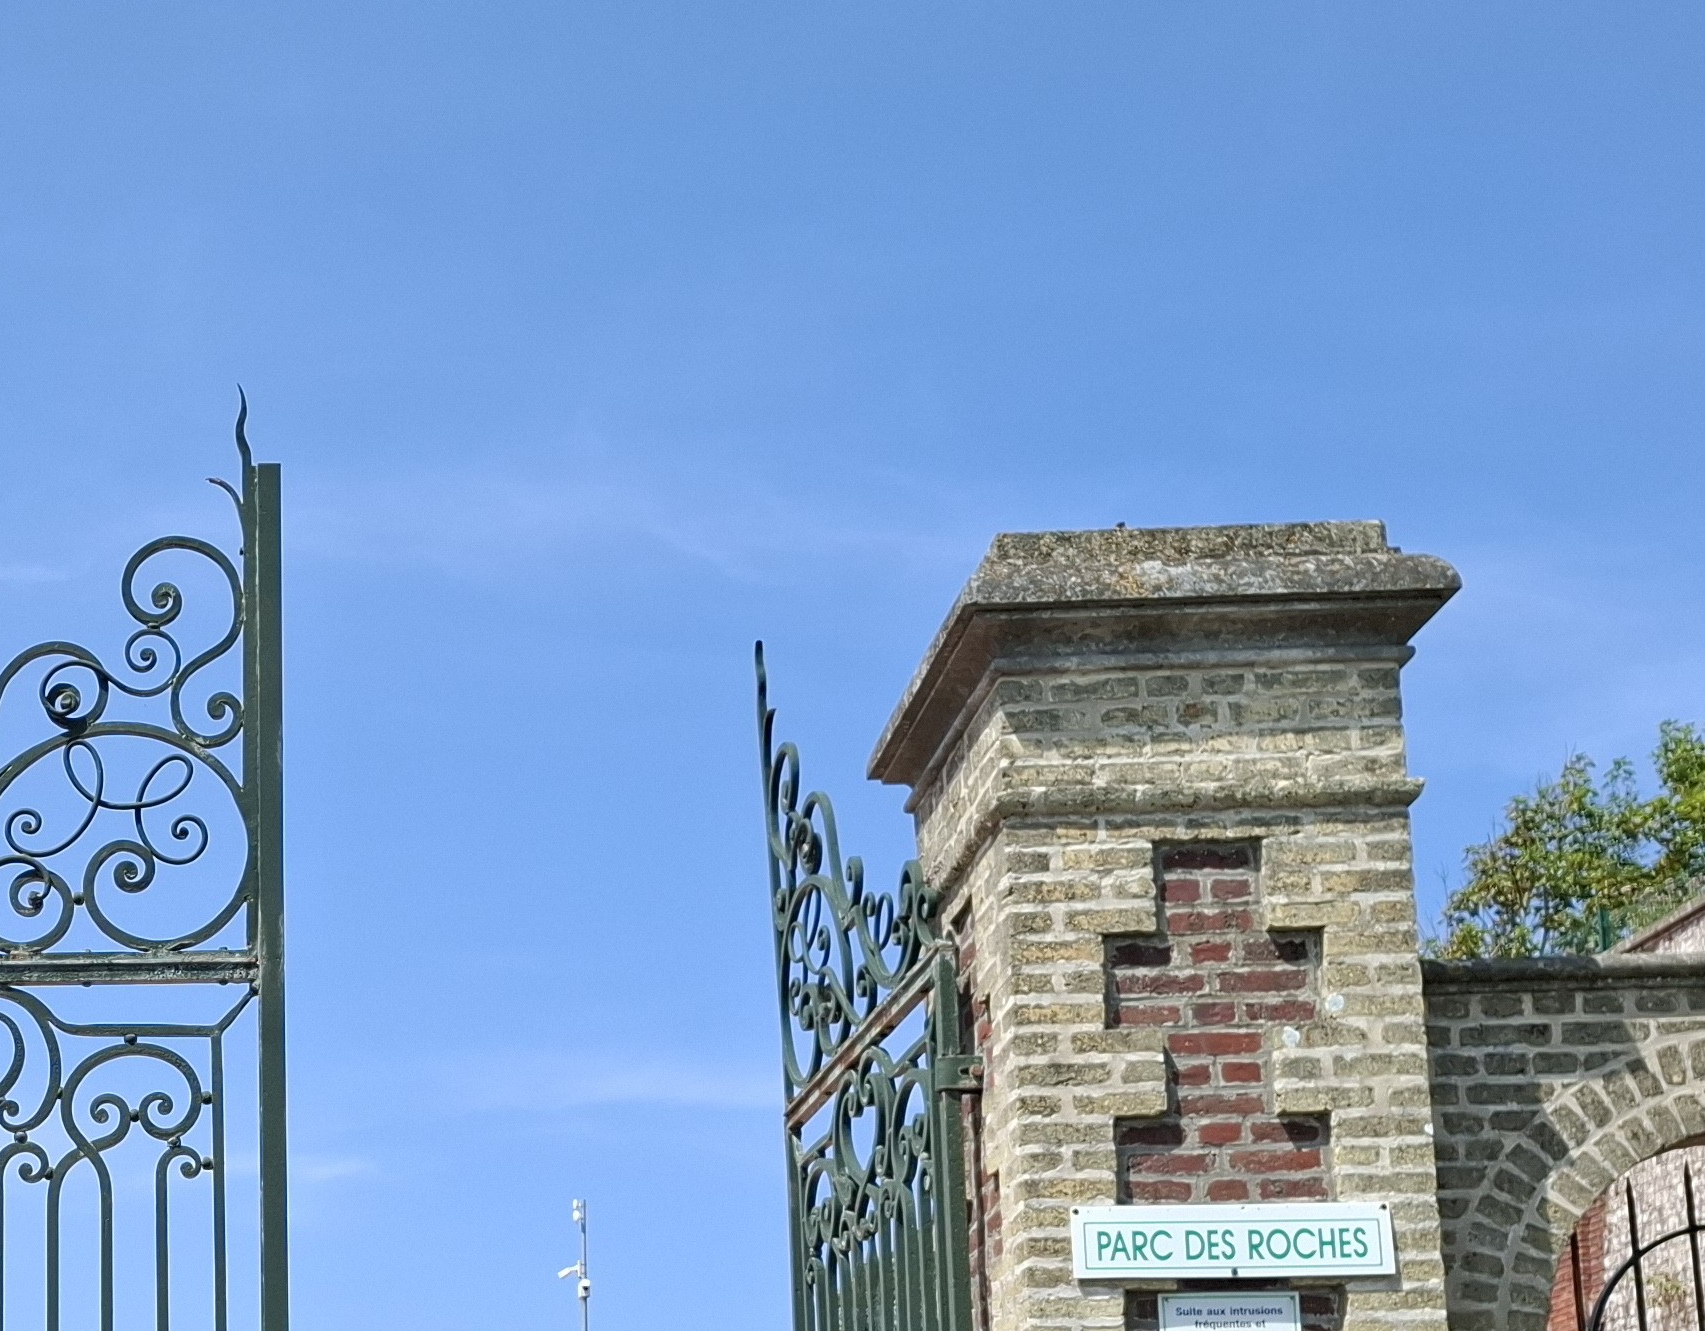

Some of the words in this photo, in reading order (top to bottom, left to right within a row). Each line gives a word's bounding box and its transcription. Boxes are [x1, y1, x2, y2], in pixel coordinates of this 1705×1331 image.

[1096, 1229, 1174, 1262] PARC
[1184, 1228, 1237, 1261] DES
[1247, 1226, 1369, 1261] ROCHES
[1175, 1307, 1203, 1316] Suite
[1206, 1308, 1226, 1316] aux
[1230, 1306, 1283, 1316] intrusions
[1195, 1320, 1252, 1331] fréquentes
[1256, 1320, 1266, 1329] et
